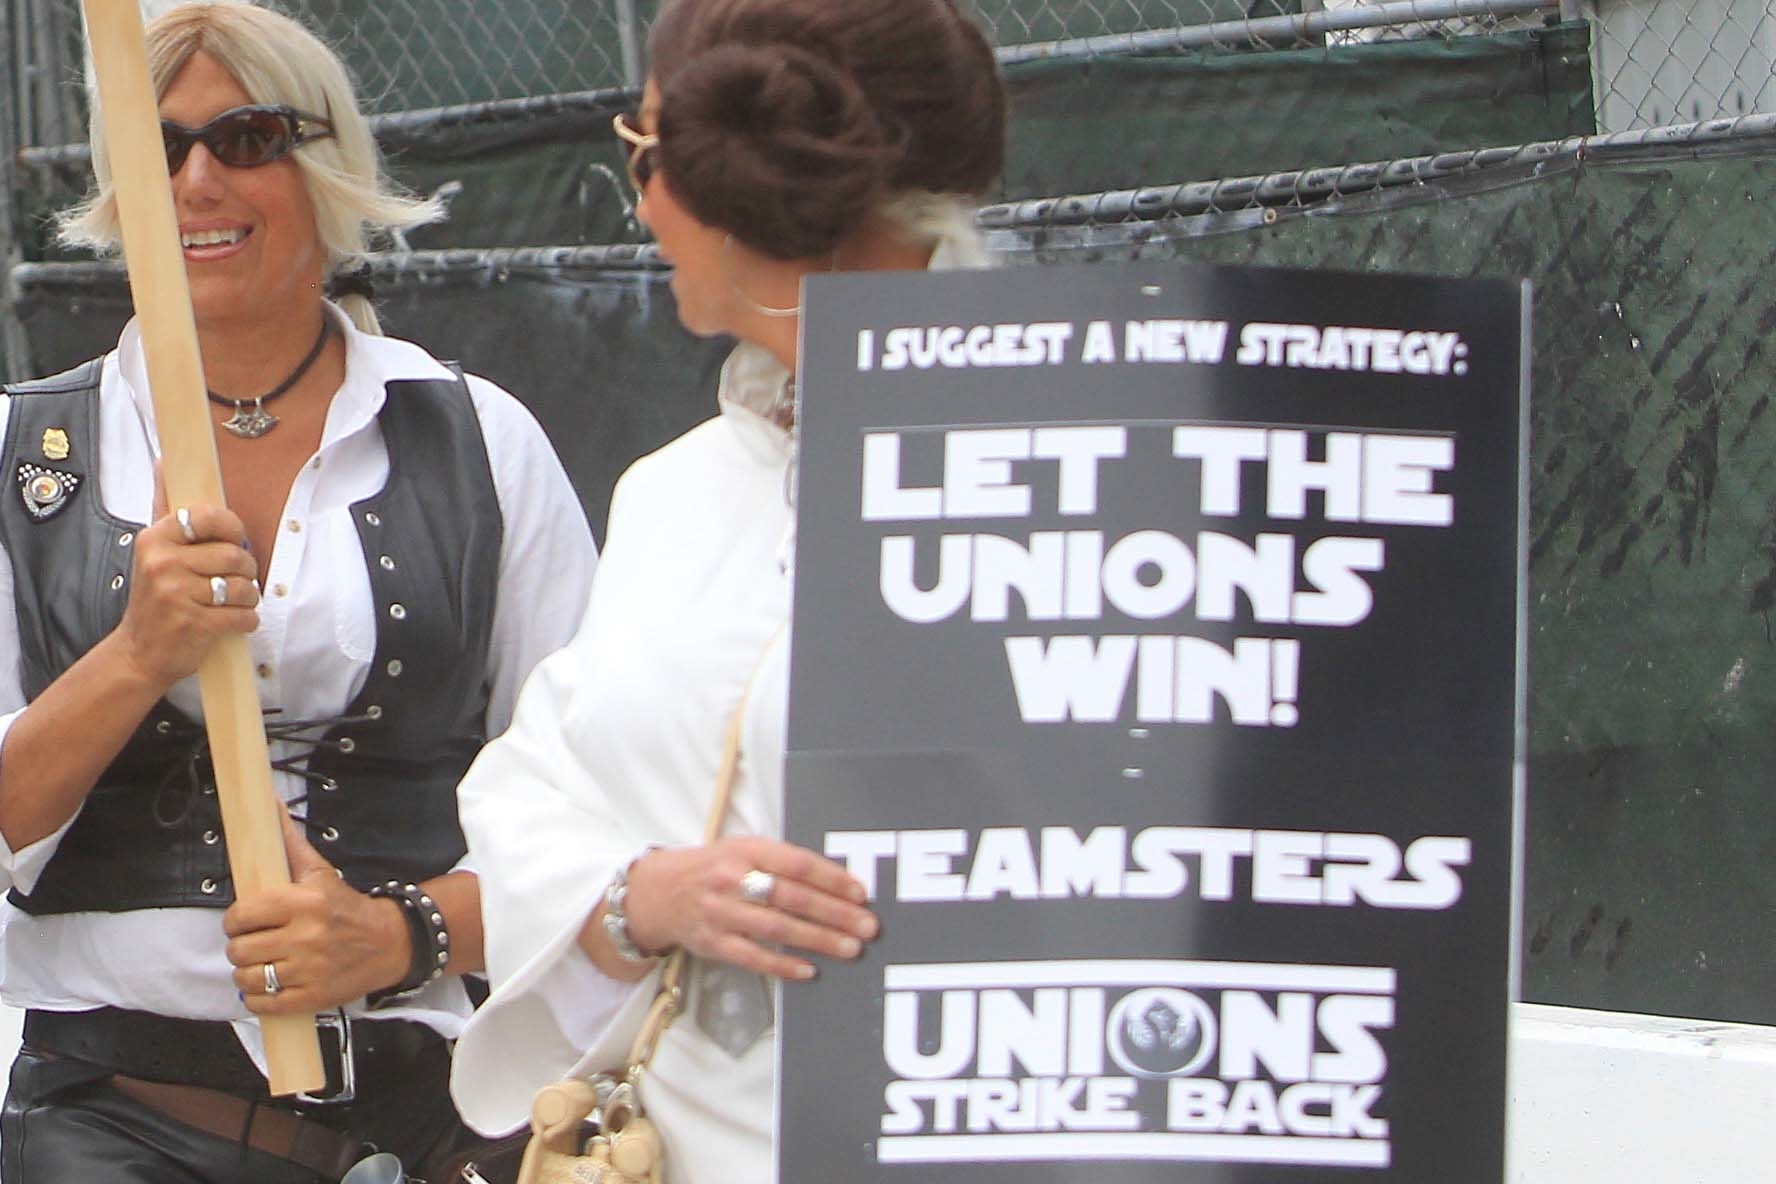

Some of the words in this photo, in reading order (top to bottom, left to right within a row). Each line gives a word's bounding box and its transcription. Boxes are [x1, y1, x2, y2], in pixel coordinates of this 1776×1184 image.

[857, 330, 874, 371] I
[881, 323, 1073, 369] SUGGEST
[1081, 321, 1115, 363] A
[1125, 319, 1228, 363] NEW
[1236, 323, 1467, 375] STRATEGY:
[861, 425, 1127, 522] LET
[1172, 425, 1455, 527] THE
[879, 530, 1385, 627] UNIONS
[1004, 634, 1300, 728] WIN!
[824, 826, 1471, 910] TEAMSTERS
[883, 987, 1396, 1082] UNIONS
[881, 1077, 1142, 1133] STRIKE
[1167, 1080, 1391, 1140] BACK
